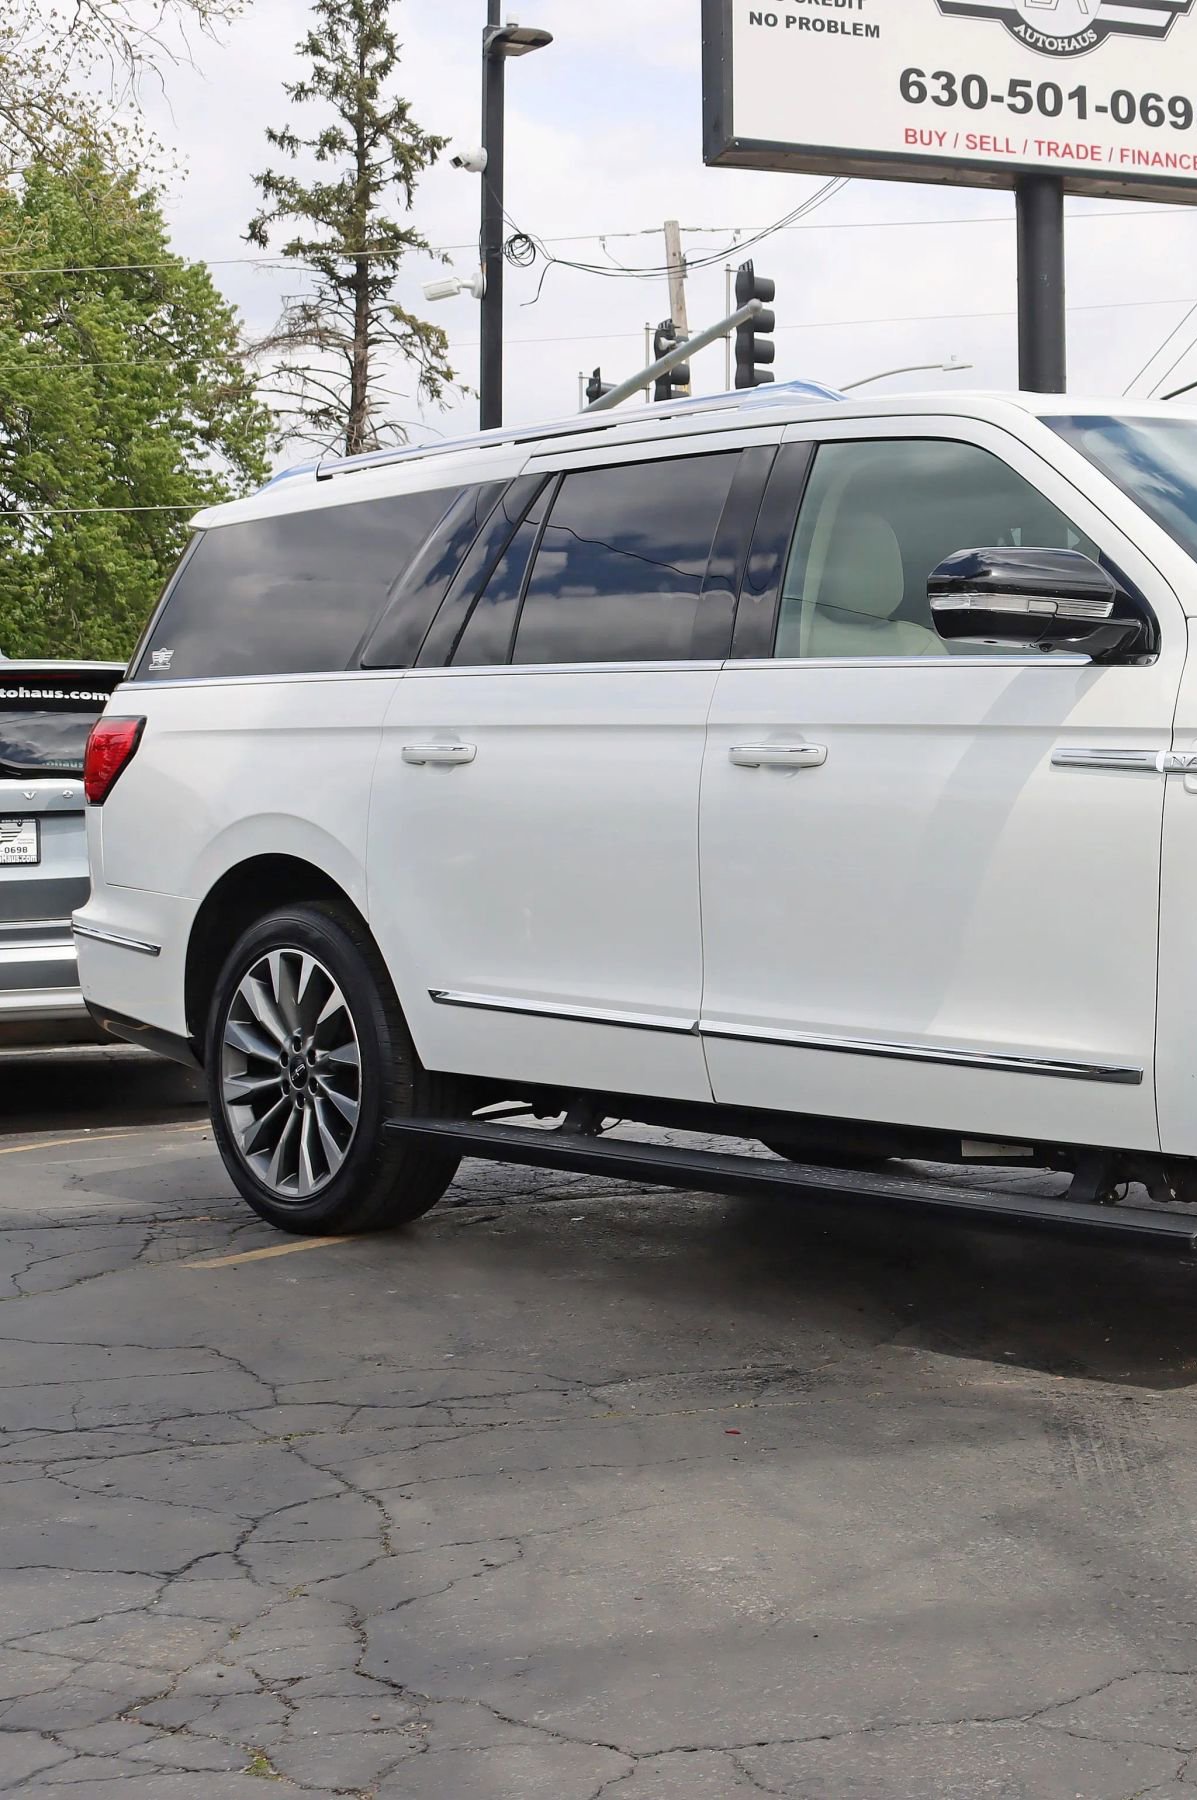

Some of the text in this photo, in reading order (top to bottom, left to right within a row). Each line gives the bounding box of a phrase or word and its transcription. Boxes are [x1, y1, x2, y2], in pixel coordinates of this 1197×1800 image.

[749, 11, 880, 38] NO PROBLEM
[1013, 23, 1098, 52] AUTOHAUS
[904, 128, 947, 148] BUY
[965, 134, 1017, 154] SELL
[1034, 140, 1102, 161] TRADE
